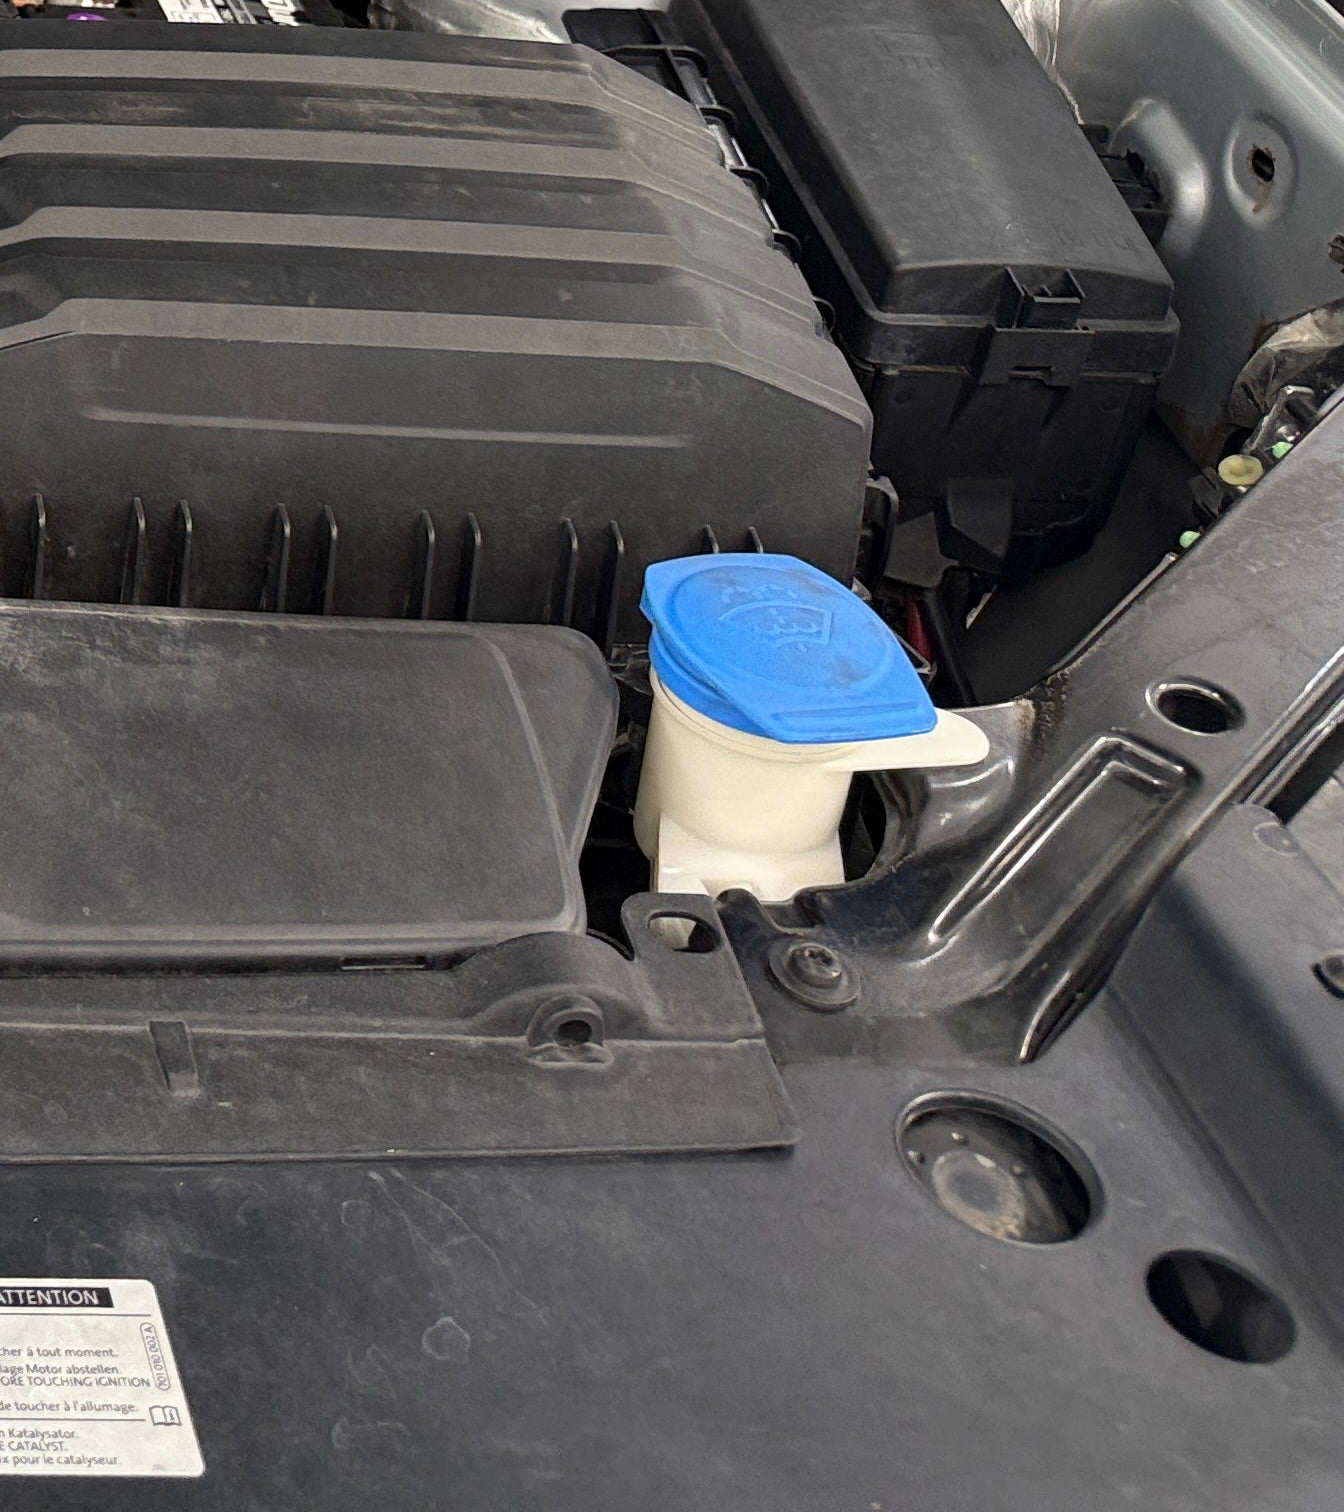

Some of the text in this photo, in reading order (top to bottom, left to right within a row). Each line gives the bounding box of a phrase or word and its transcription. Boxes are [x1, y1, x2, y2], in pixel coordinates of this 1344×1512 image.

[36, 1348, 61, 1357] tout
[26, 1365, 62, 1374] Motor
[27, 1377, 93, 1387] TOUCHING
[95, 1377, 151, 1387] IGNITION
[14, 1401, 60, 1410] toucher
[12, 1457, 39, 1467] pour
[43, 1455, 54, 1464] le
